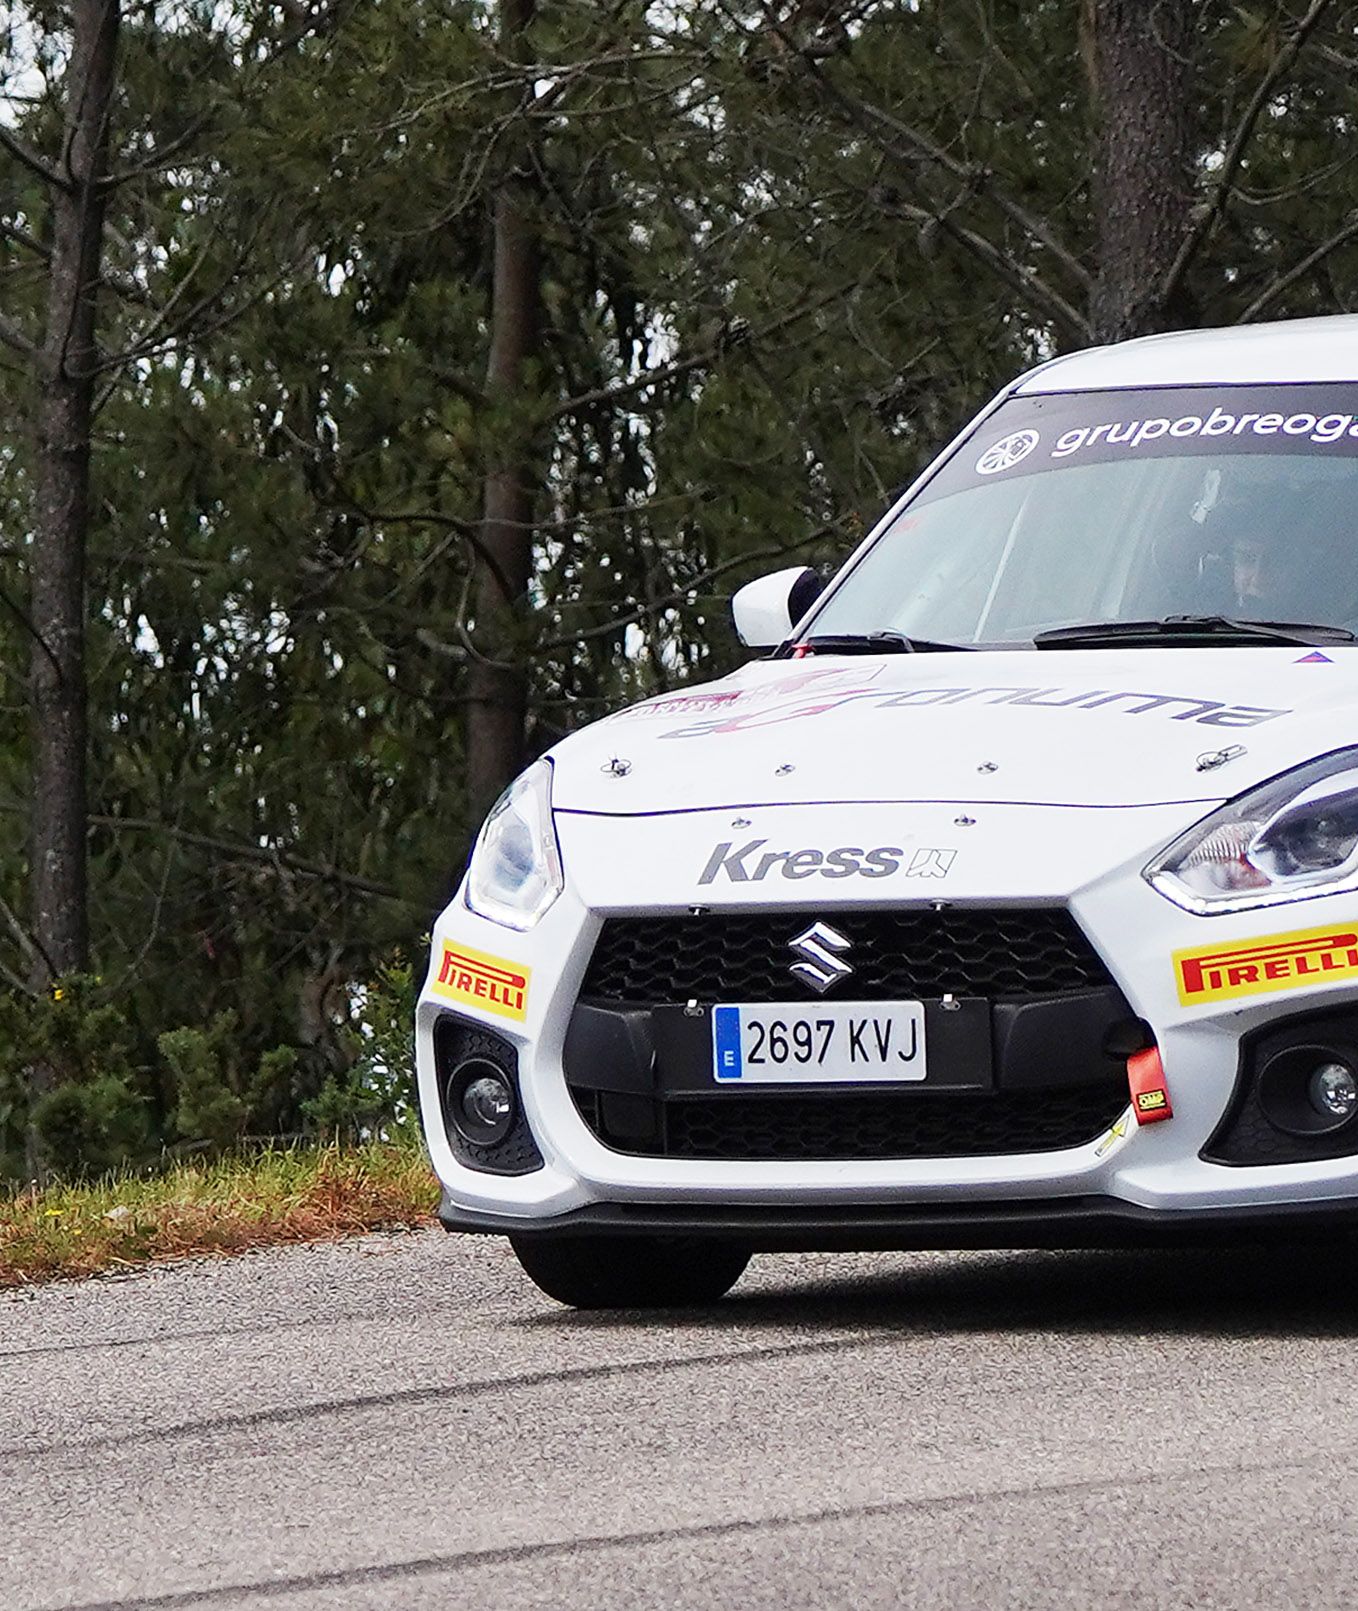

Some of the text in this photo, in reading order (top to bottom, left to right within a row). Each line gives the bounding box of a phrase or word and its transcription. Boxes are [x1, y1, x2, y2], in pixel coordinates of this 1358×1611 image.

[697, 839, 905, 886] Kress
[438, 949, 526, 1011] PIRELLI
[723, 1050, 735, 1067] E
[747, 1018, 918, 1064] 2697 KVJ
